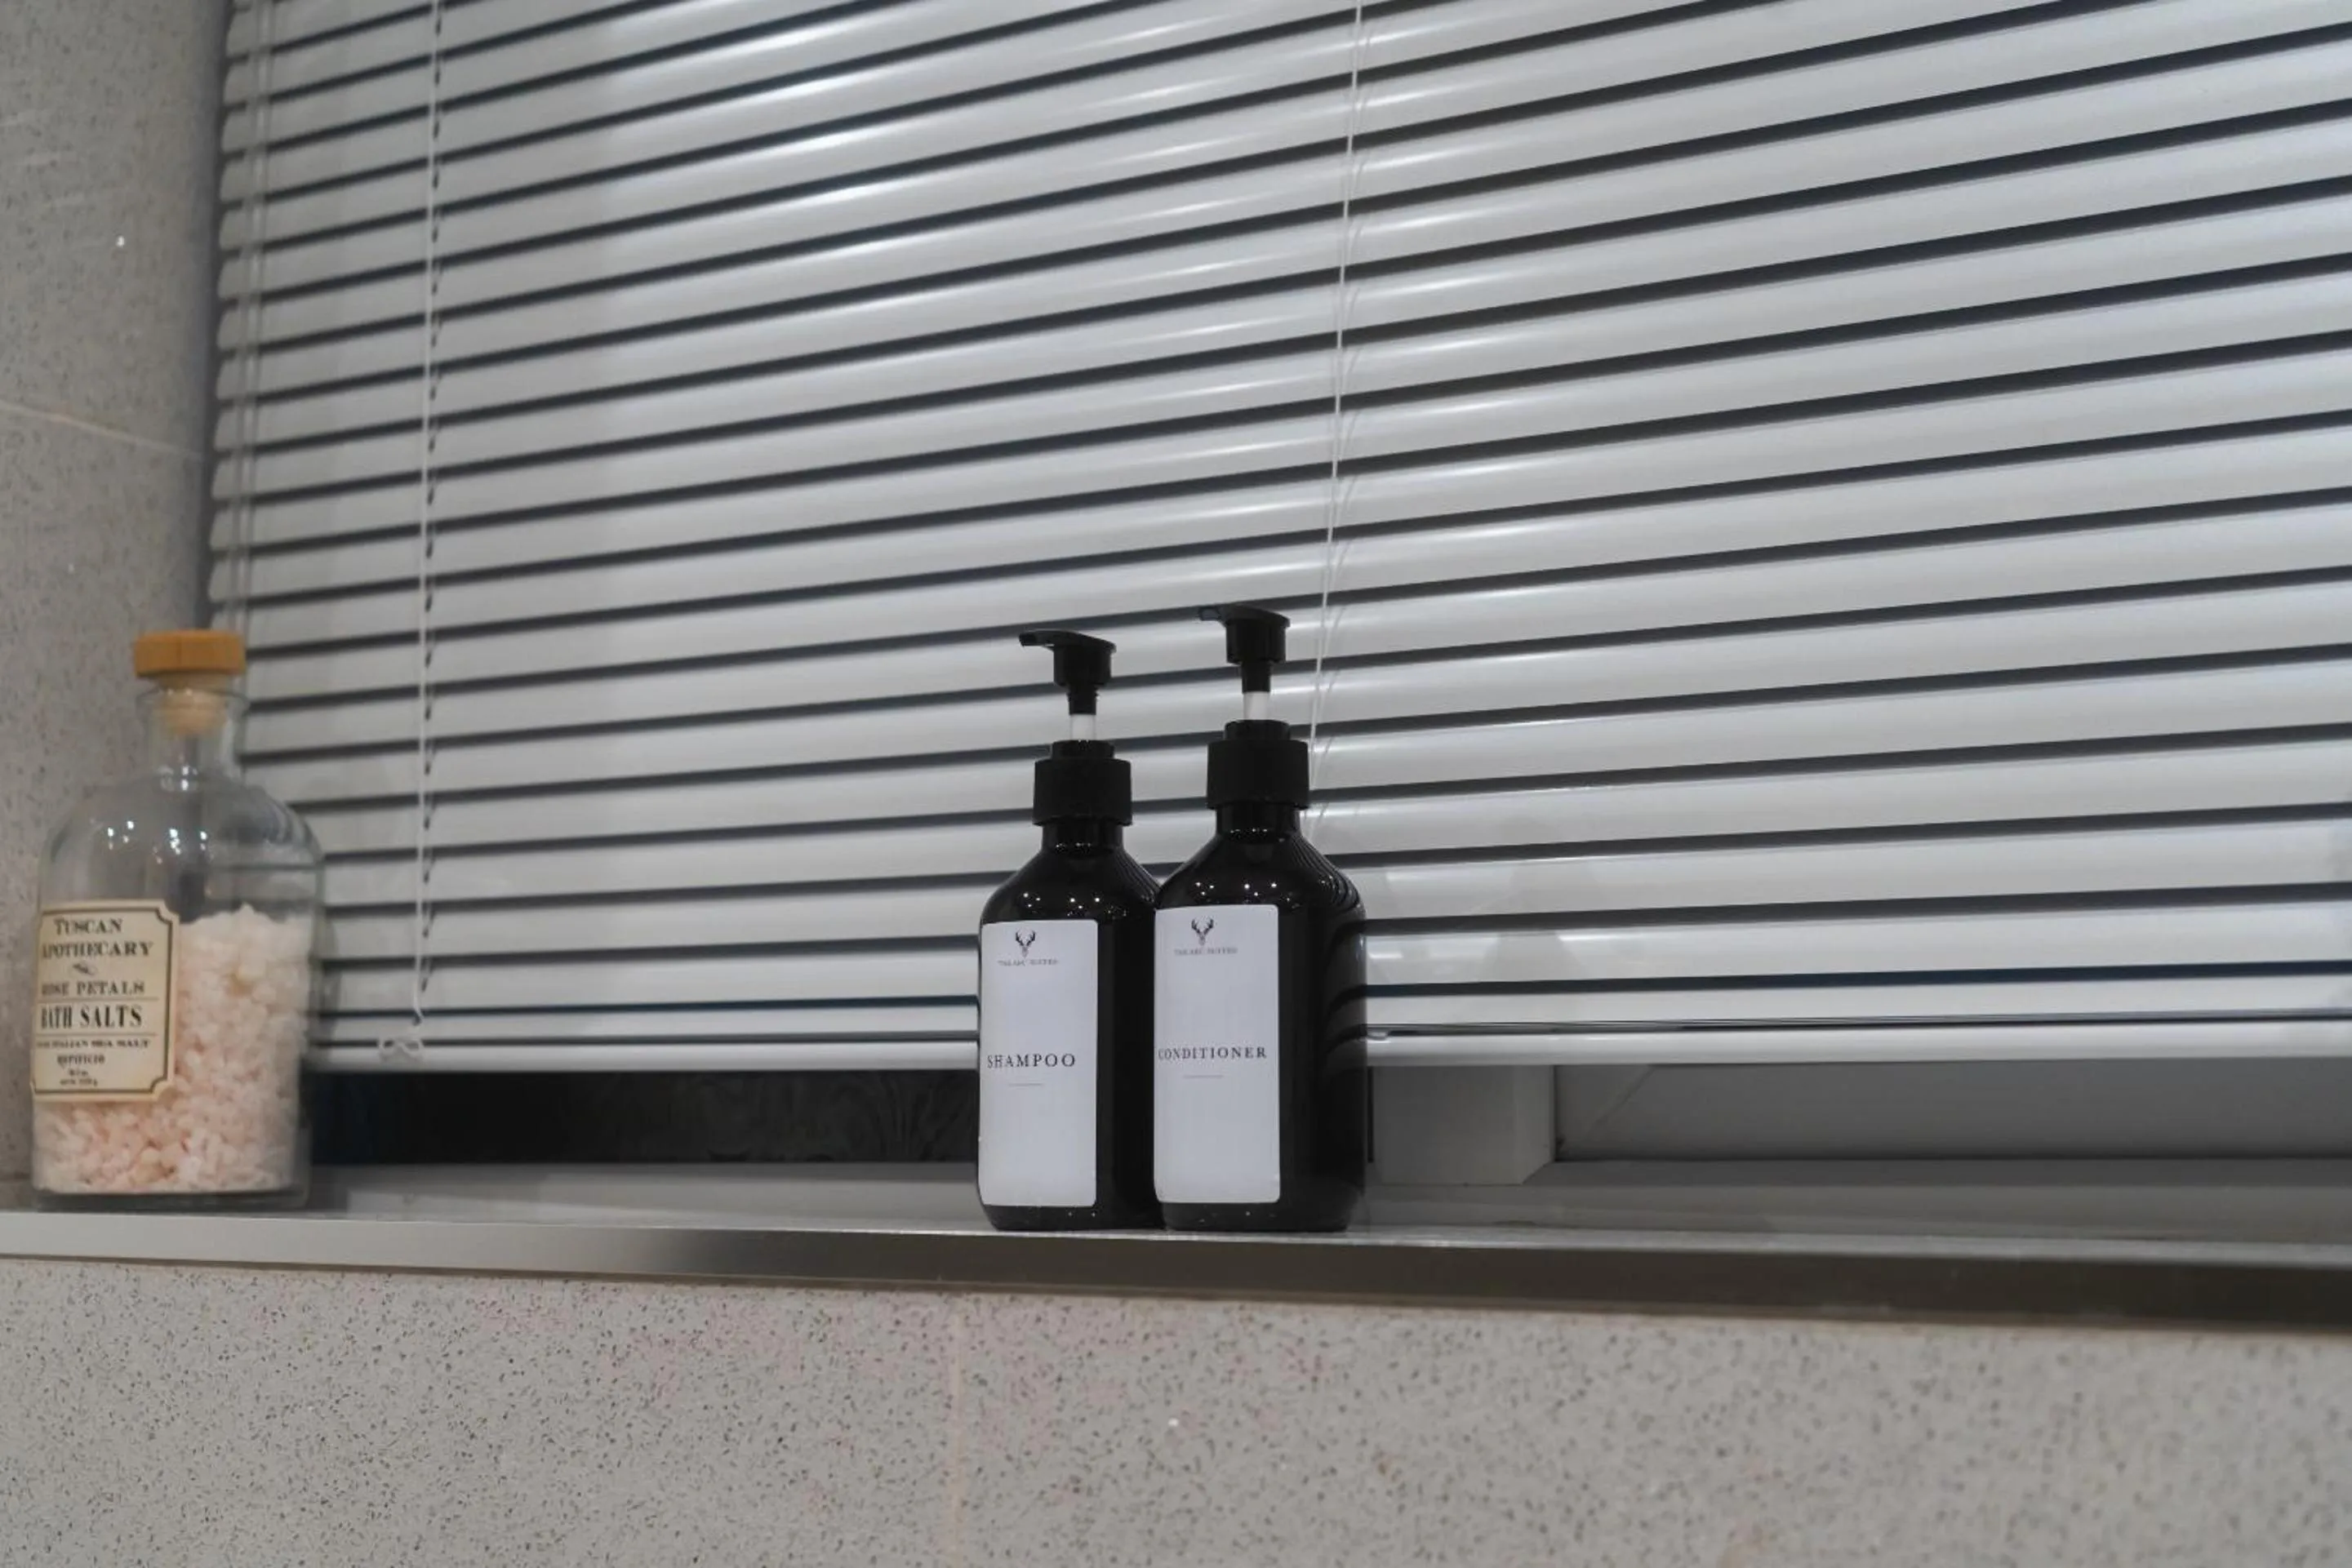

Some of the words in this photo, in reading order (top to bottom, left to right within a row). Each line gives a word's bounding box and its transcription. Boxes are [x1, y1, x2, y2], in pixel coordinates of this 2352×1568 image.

[54, 917, 122, 935] TUSCAN
[76, 981, 145, 995] PETALS
[80, 1004, 142, 1028] SALTS
[986, 1053, 1076, 1068] SHAMPOO
[1158, 1046, 1267, 1060] CONDITIONER
